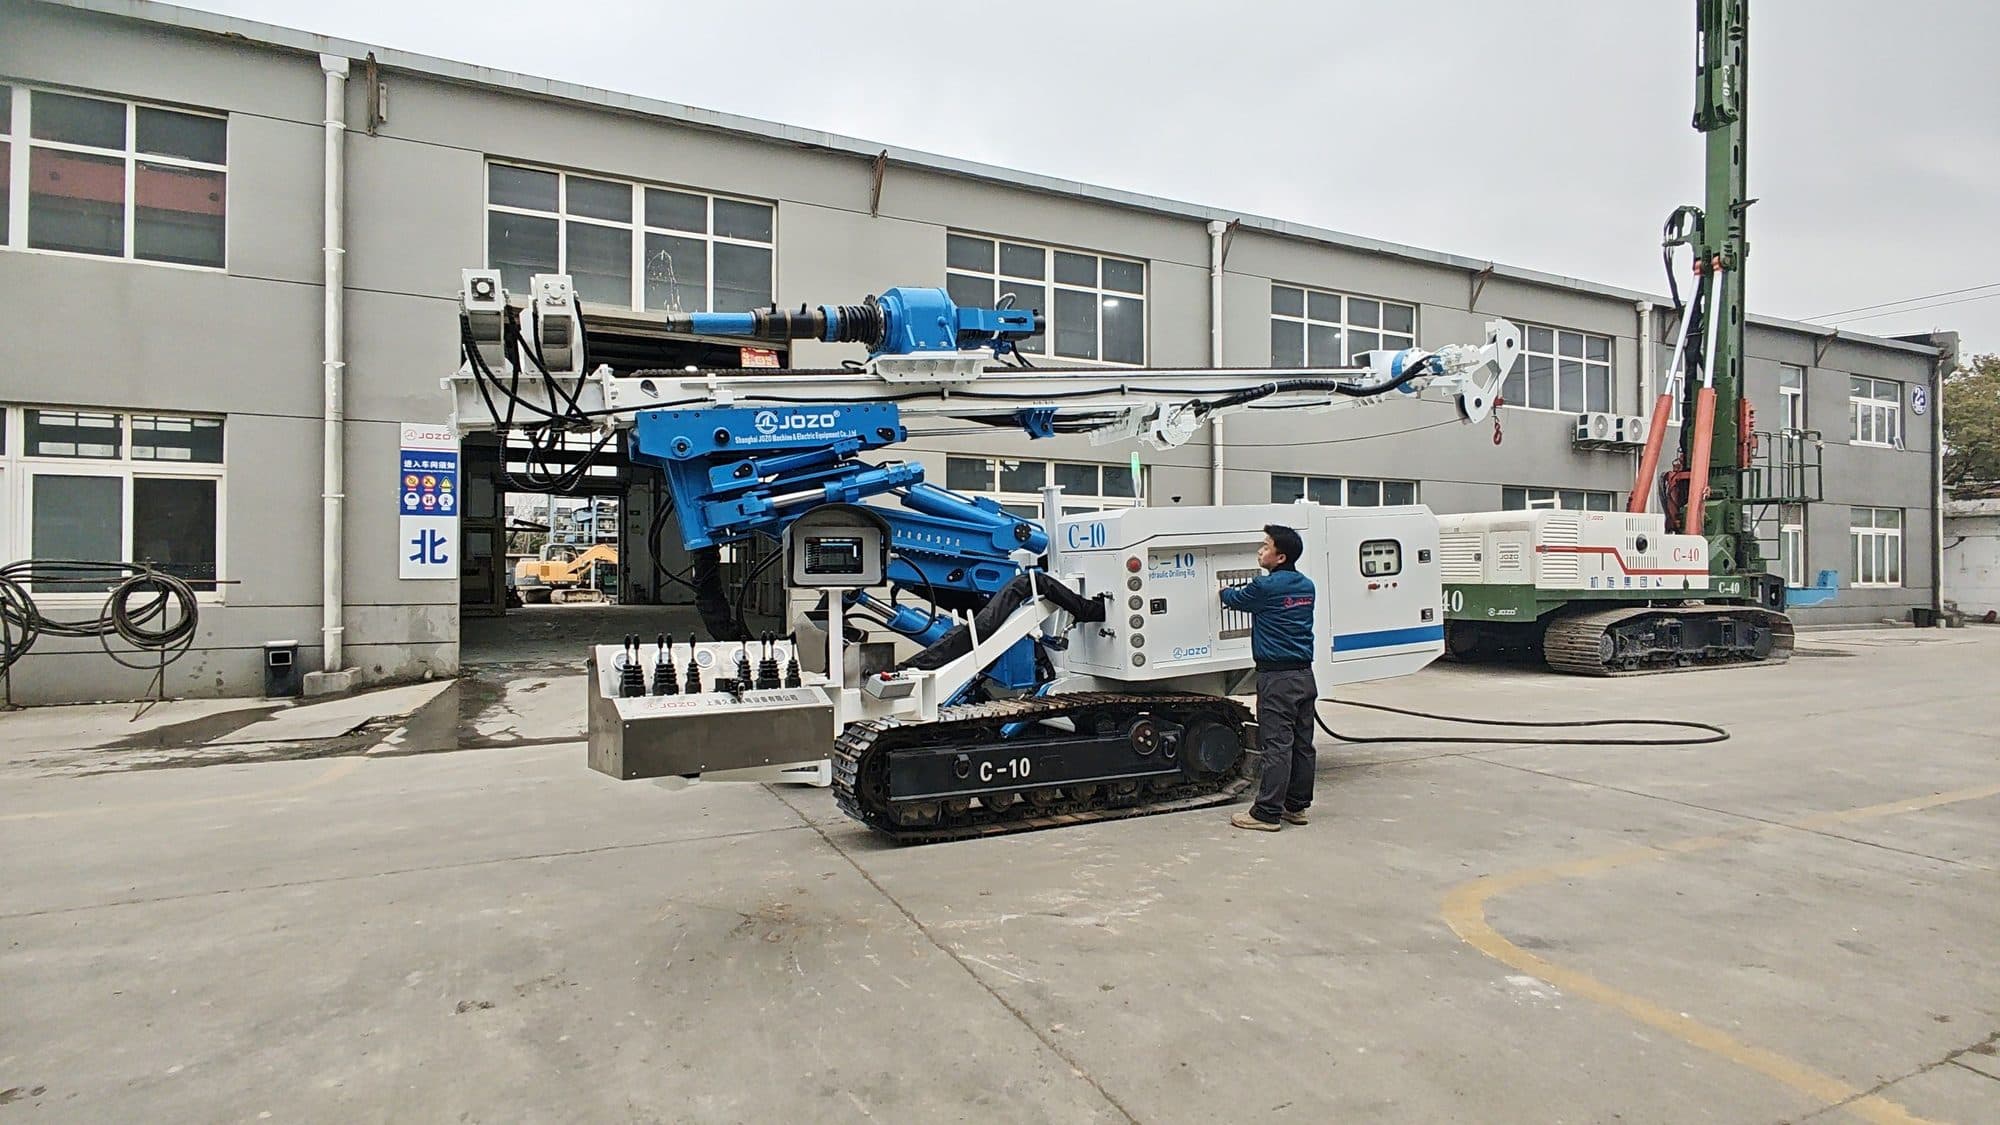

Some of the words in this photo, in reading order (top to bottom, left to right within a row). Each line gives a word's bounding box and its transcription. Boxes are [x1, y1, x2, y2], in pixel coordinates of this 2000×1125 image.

[779, 414, 835, 430] JOZO
[418, 432, 451, 441] JOZO
[734, 435, 758, 445] Shanghai
[758, 434, 772, 443] JOZO
[403, 460, 456, 469] 进入车间须知
[1068, 522, 1105, 549] C-10
[409, 529, 448, 564] 北
[1673, 547, 1700, 562] C-40
[1148, 552, 1194, 571] C-10
[1718, 582, 1740, 594] C-40
[1183, 646, 1208, 657] JOZO
[659, 701, 697, 709] JOZO
[980, 757, 1031, 782] C-10
